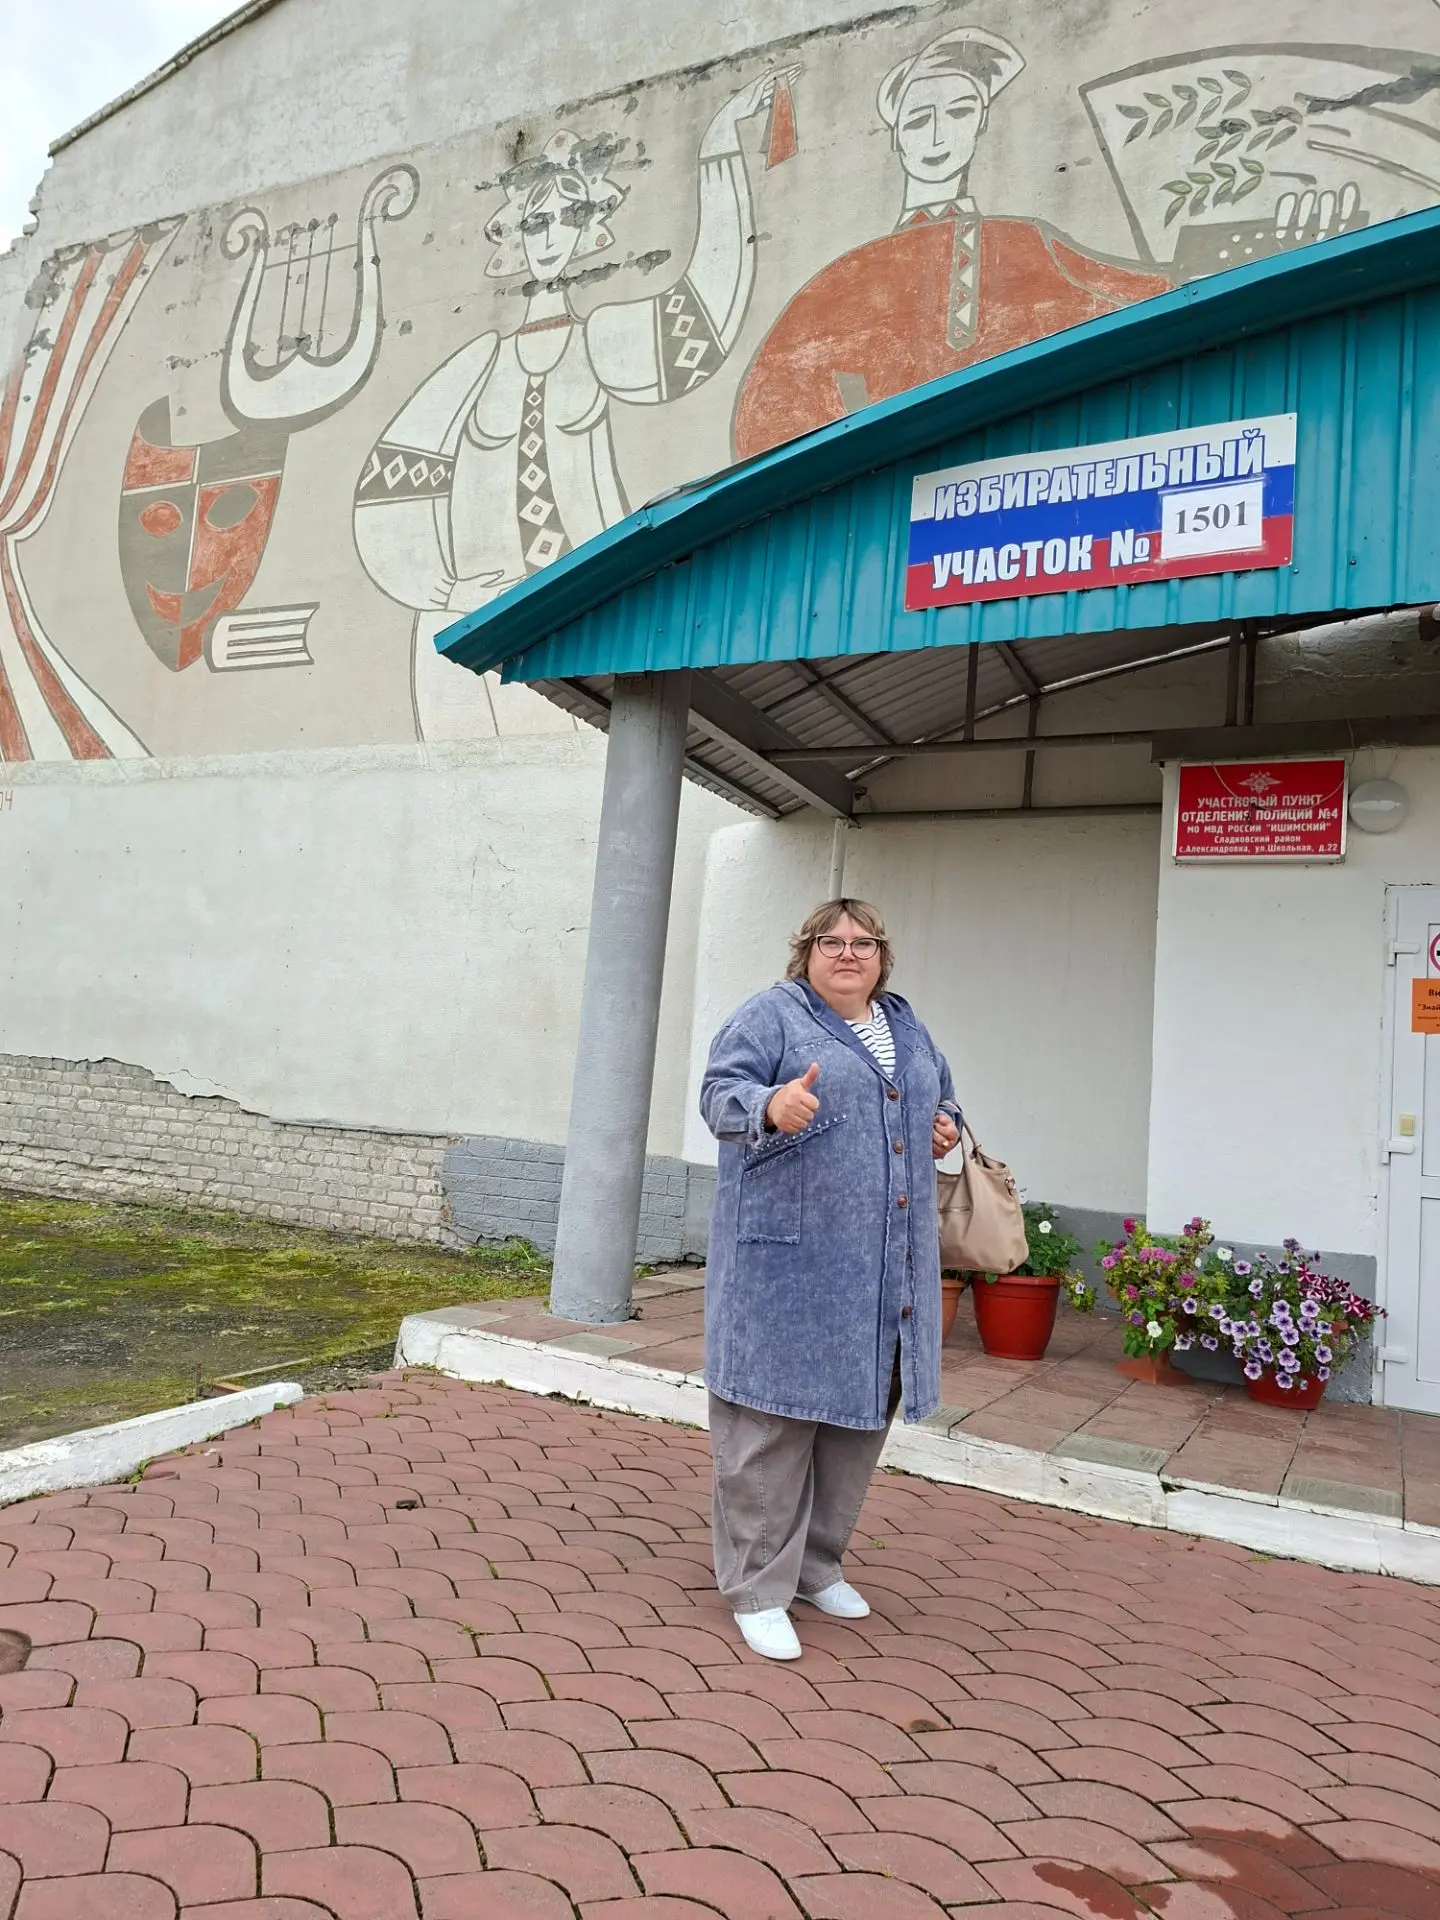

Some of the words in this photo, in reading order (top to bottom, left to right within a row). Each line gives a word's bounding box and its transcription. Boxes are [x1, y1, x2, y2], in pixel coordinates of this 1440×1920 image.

[934, 428, 1265, 521] ИЗБИРАТЕЛЬНЫЙ
[932, 534, 1093, 589] УЧАСТОК
[1109, 529, 1150, 568] №
[1175, 500, 1249, 534] 1501
[1198, 794, 1278, 808] УЧАСТКОВЫЙ
[1282, 794, 1323, 806] ПУНКТ
[1256, 809, 1313, 821] ПОЛИЦИИ
[1187, 825, 1200, 833] МО
[1204, 825, 1223, 834] МВД
[1228, 824, 1261, 833] РОССИИ
[1214, 835, 1270, 844] Сладковский
[1274, 835, 1301, 843] район
